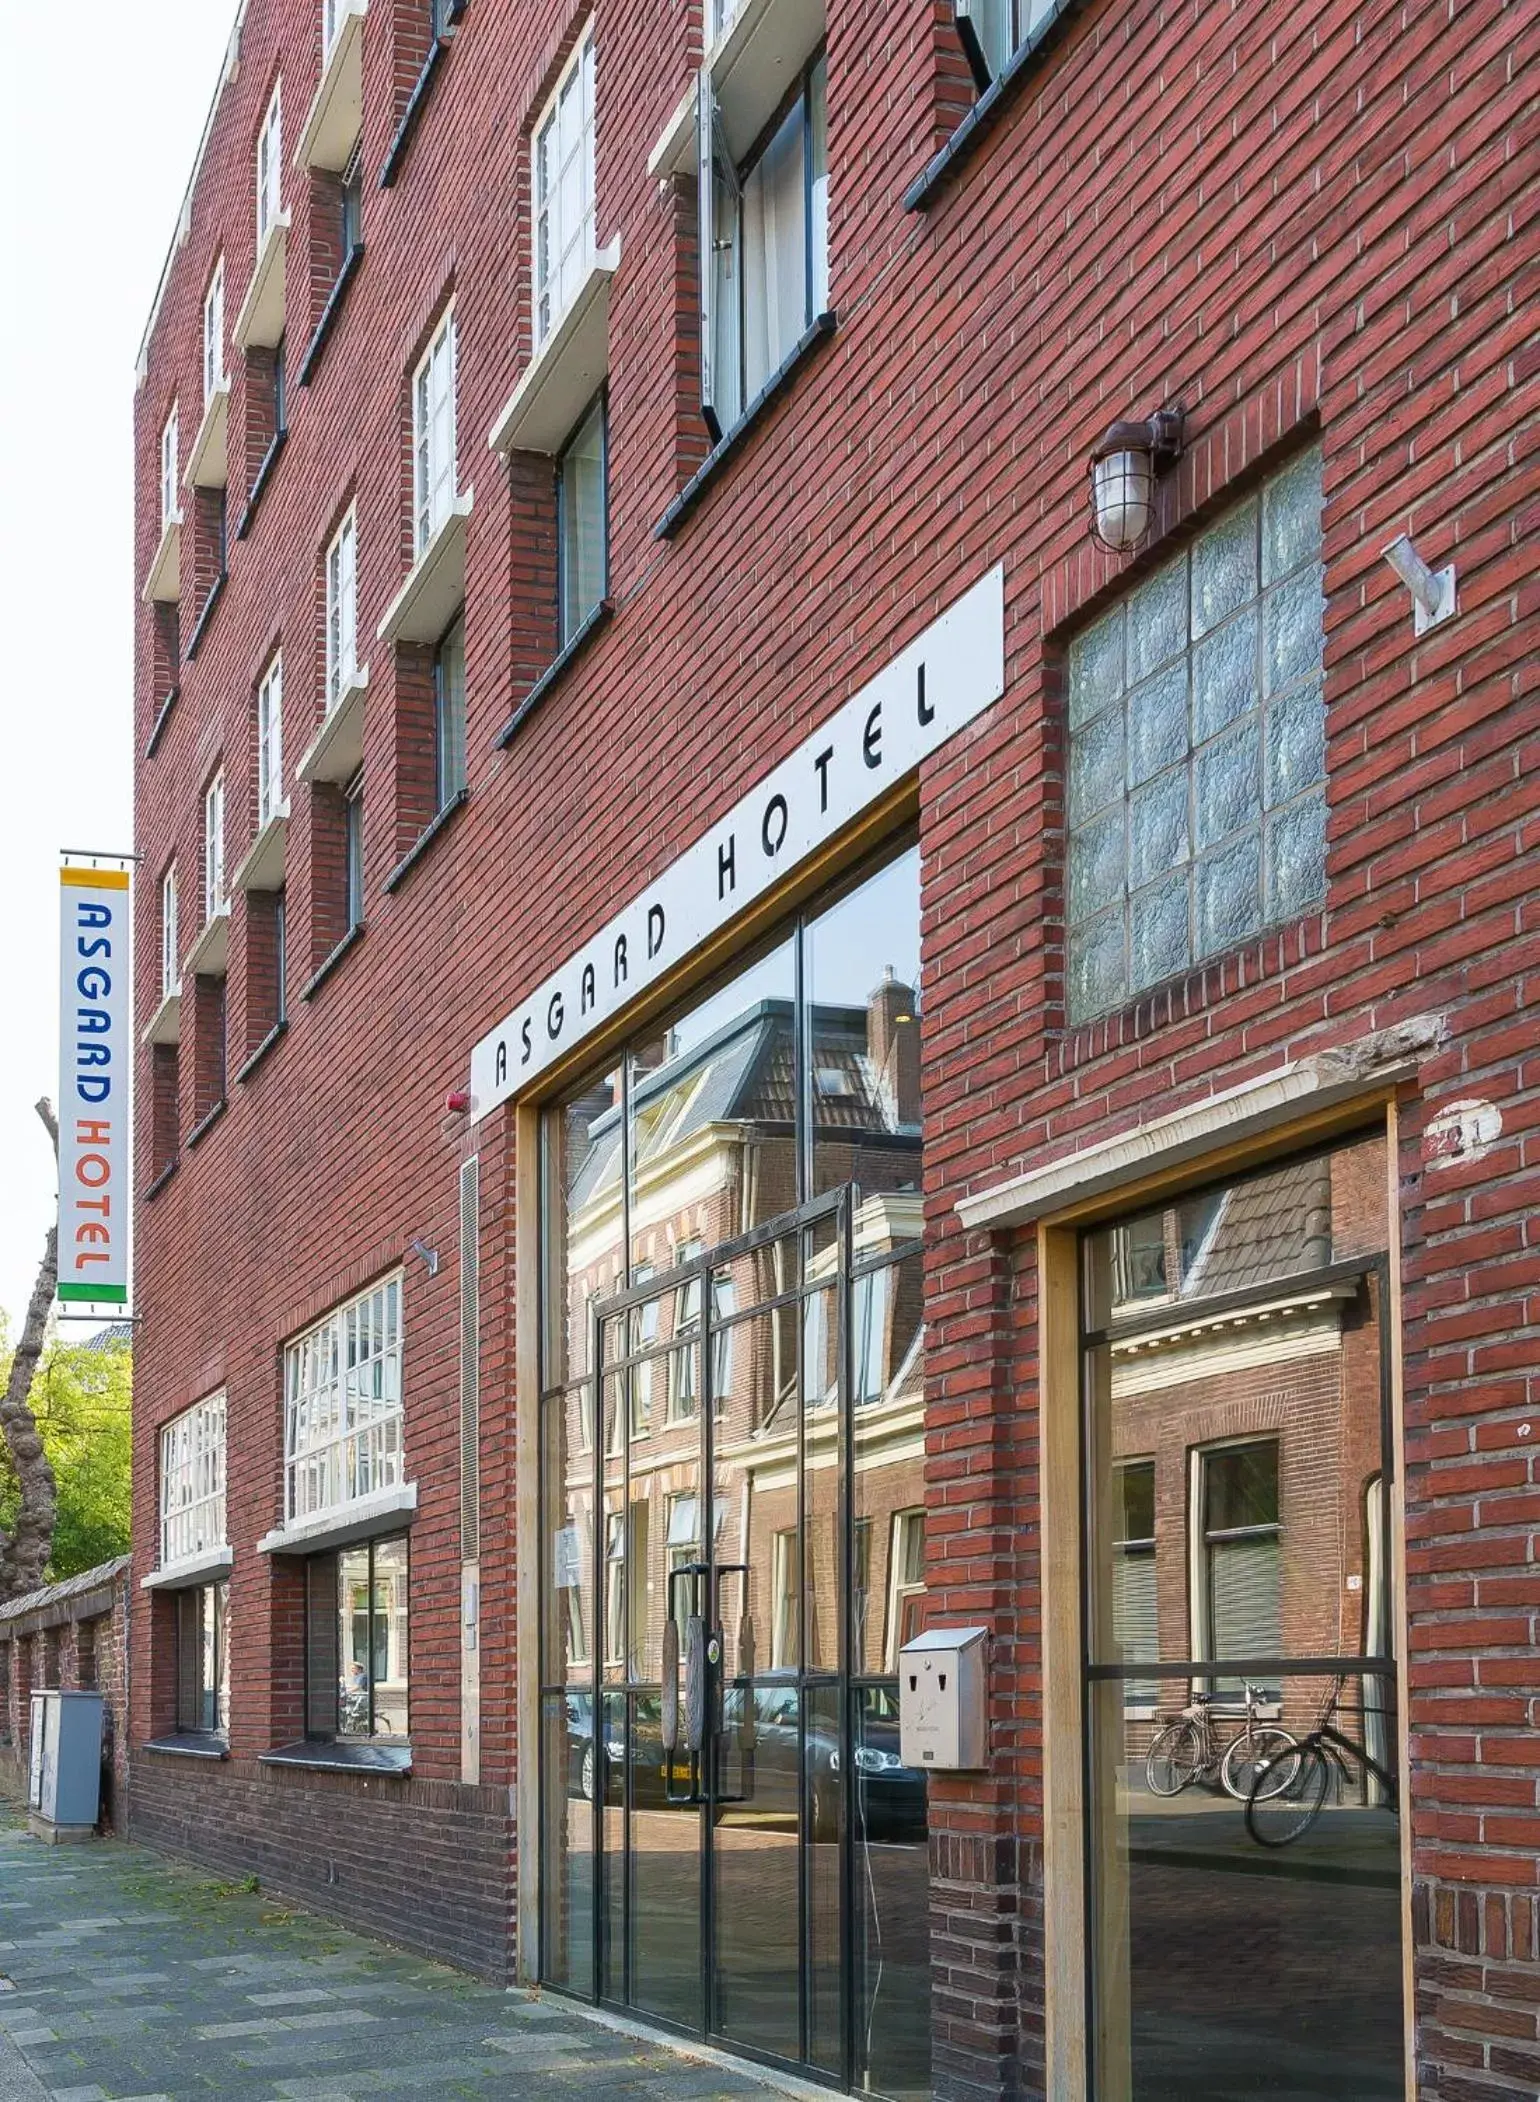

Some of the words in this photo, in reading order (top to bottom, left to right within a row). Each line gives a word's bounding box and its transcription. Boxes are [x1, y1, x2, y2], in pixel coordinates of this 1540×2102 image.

[496, 904, 666, 1087] ASGARD
[718, 662, 935, 900] HOTEL
[76, 903, 112, 1103] ASGARD
[75, 1119, 110, 1269] HOTEL
